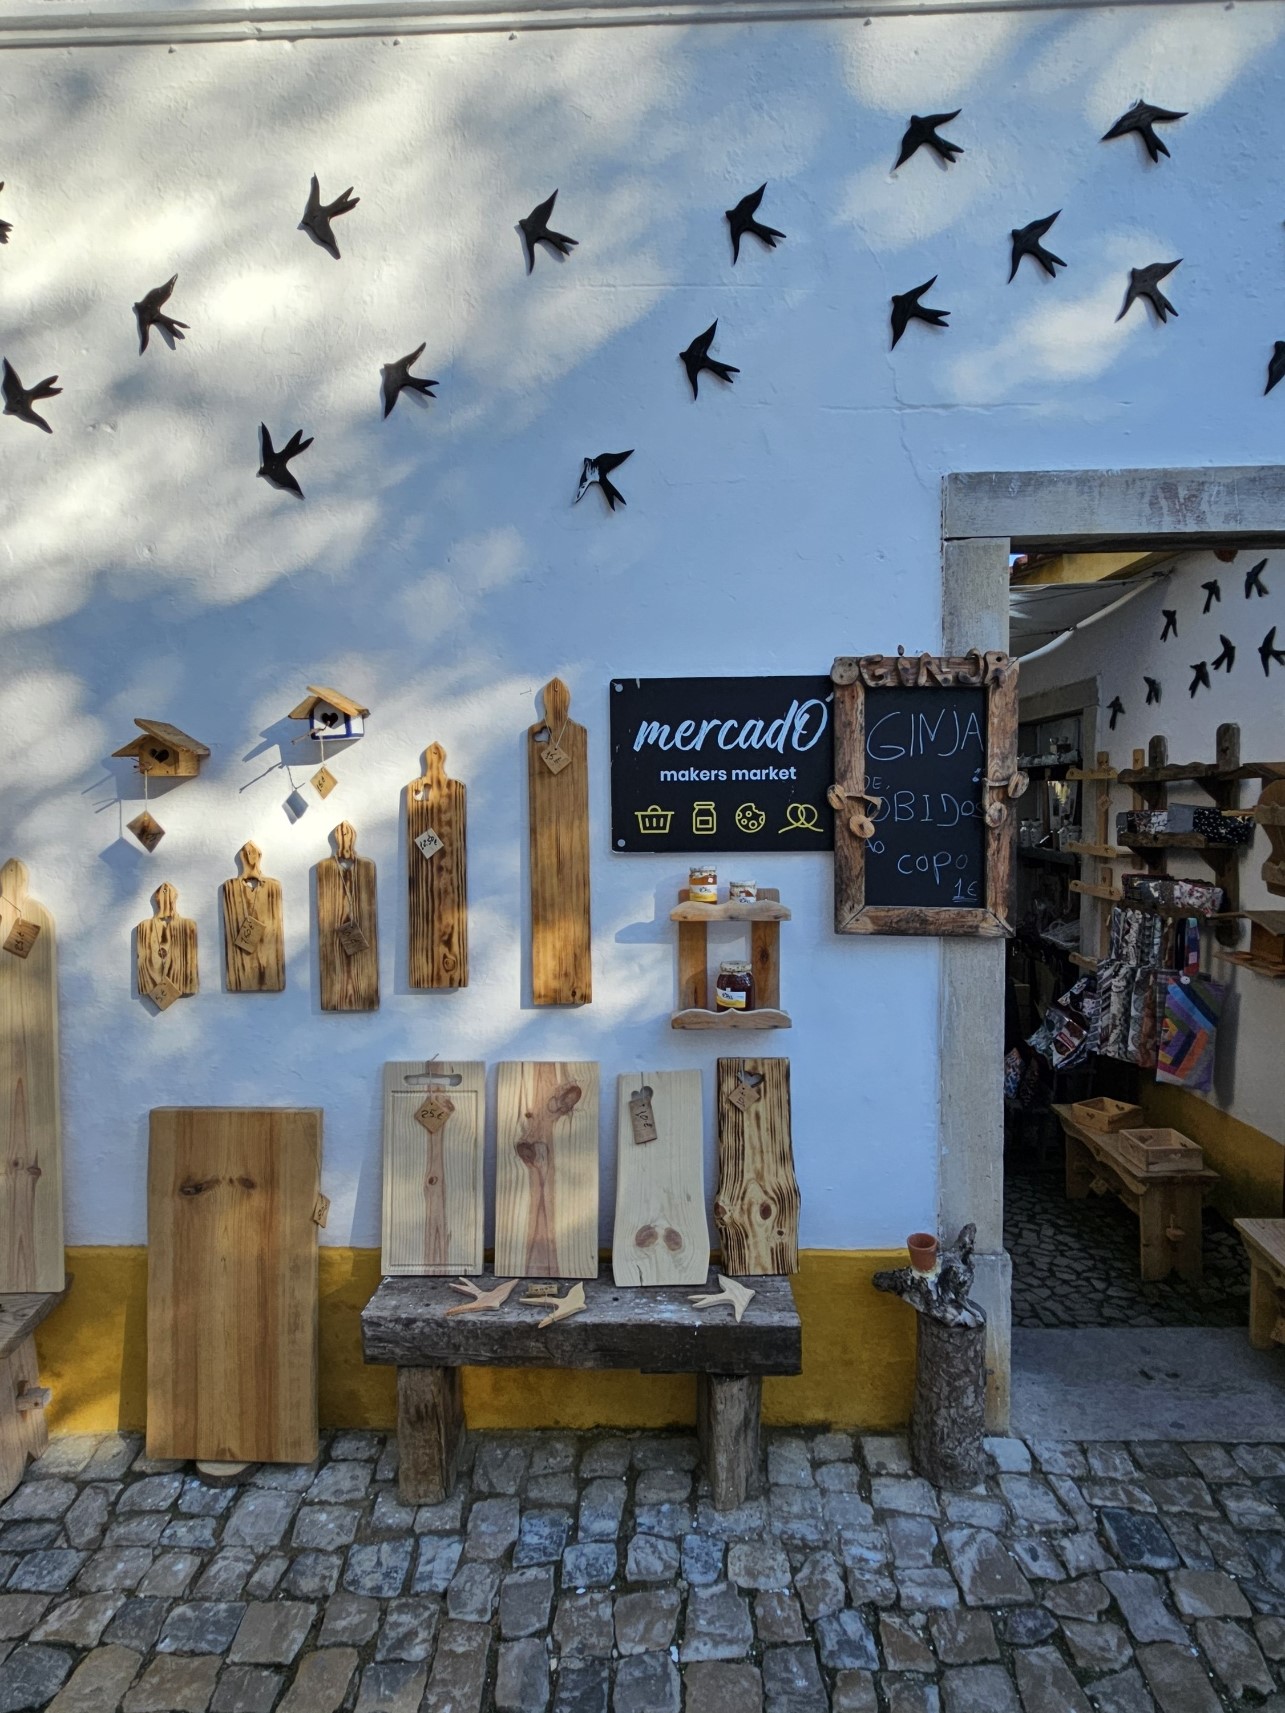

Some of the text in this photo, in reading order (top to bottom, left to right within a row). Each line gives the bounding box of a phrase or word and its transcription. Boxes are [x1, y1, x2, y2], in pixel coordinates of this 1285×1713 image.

[866, 704, 984, 761] GINJA
[660, 766, 797, 781] makers market
